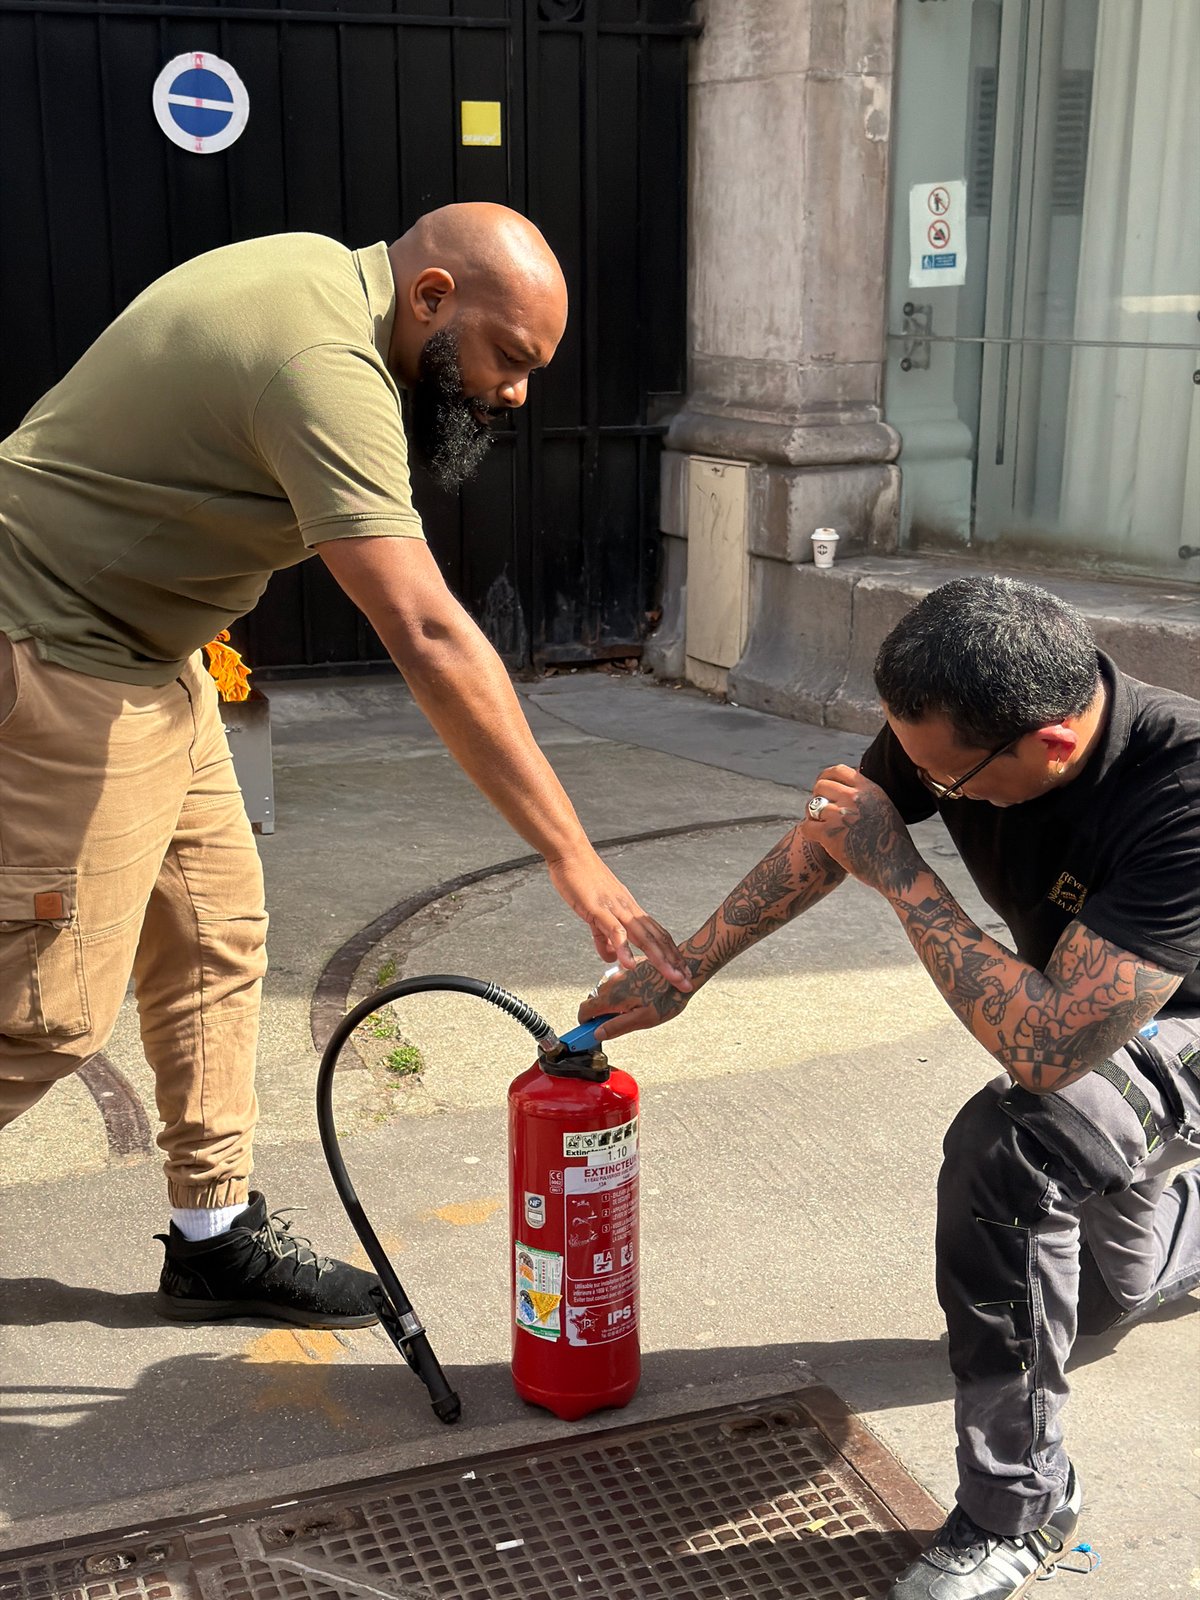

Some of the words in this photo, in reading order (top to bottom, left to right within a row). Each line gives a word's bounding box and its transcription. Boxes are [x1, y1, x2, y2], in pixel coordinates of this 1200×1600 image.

[608, 1145, 627, 1161] 1.10
[530, 1199, 541, 1207] NF
[608, 1305, 631, 1326] IPS
